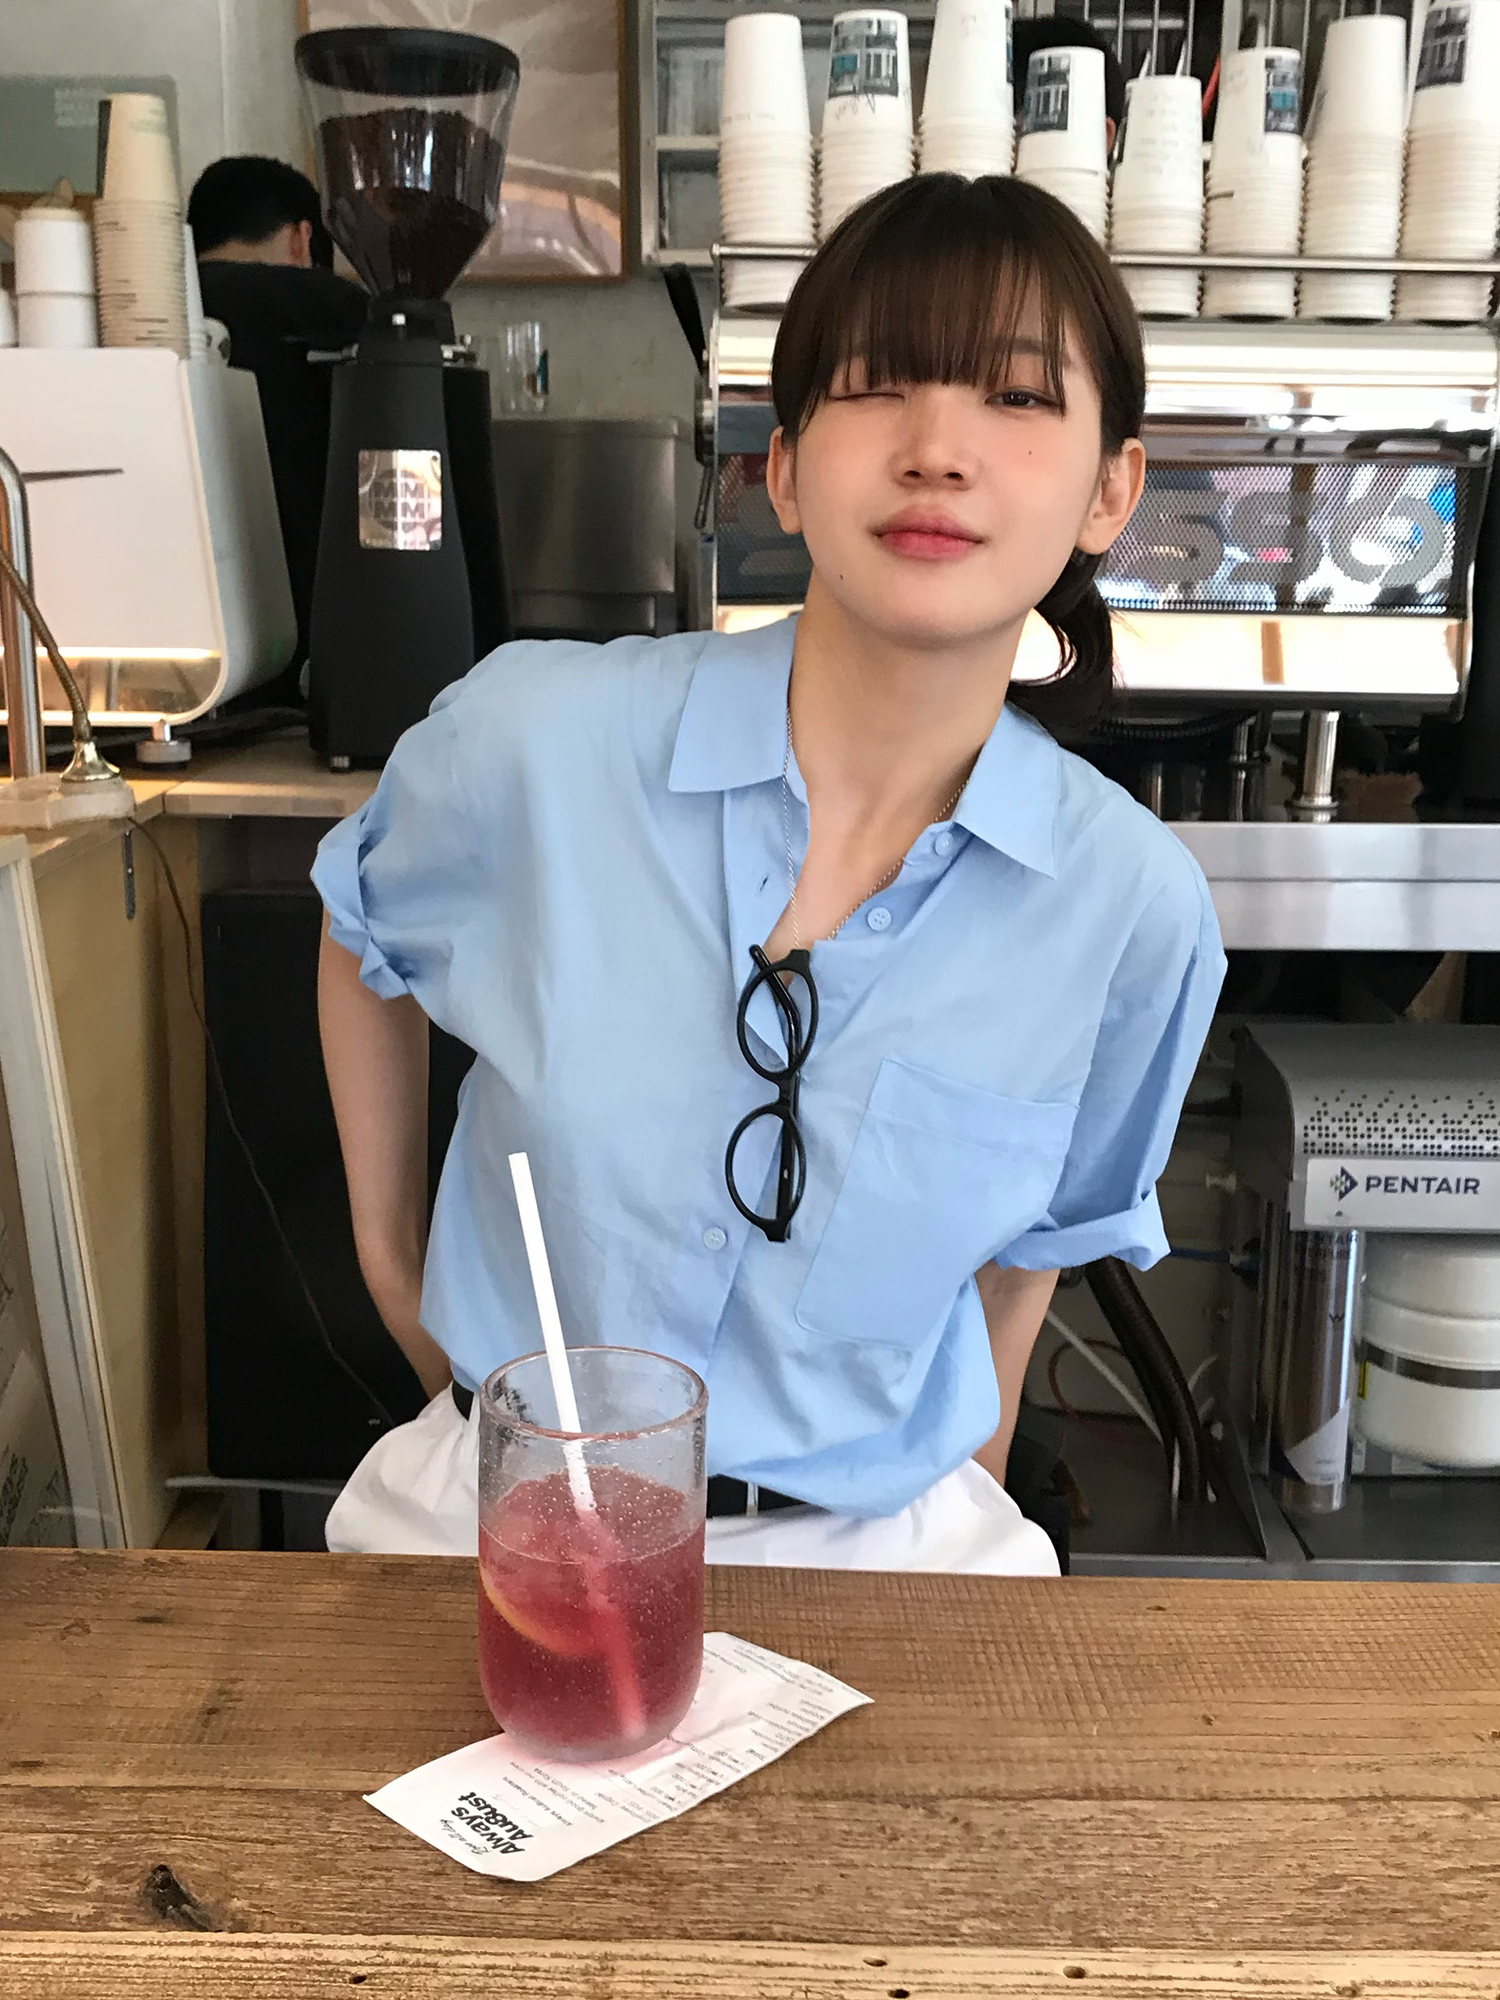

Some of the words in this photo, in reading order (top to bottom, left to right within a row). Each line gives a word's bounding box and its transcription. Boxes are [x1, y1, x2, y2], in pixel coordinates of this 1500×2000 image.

[1365, 1175, 1481, 1195] PENTAIR
[503, 1777, 529, 1796] Roasters
[451, 1807, 525, 1855] Always
